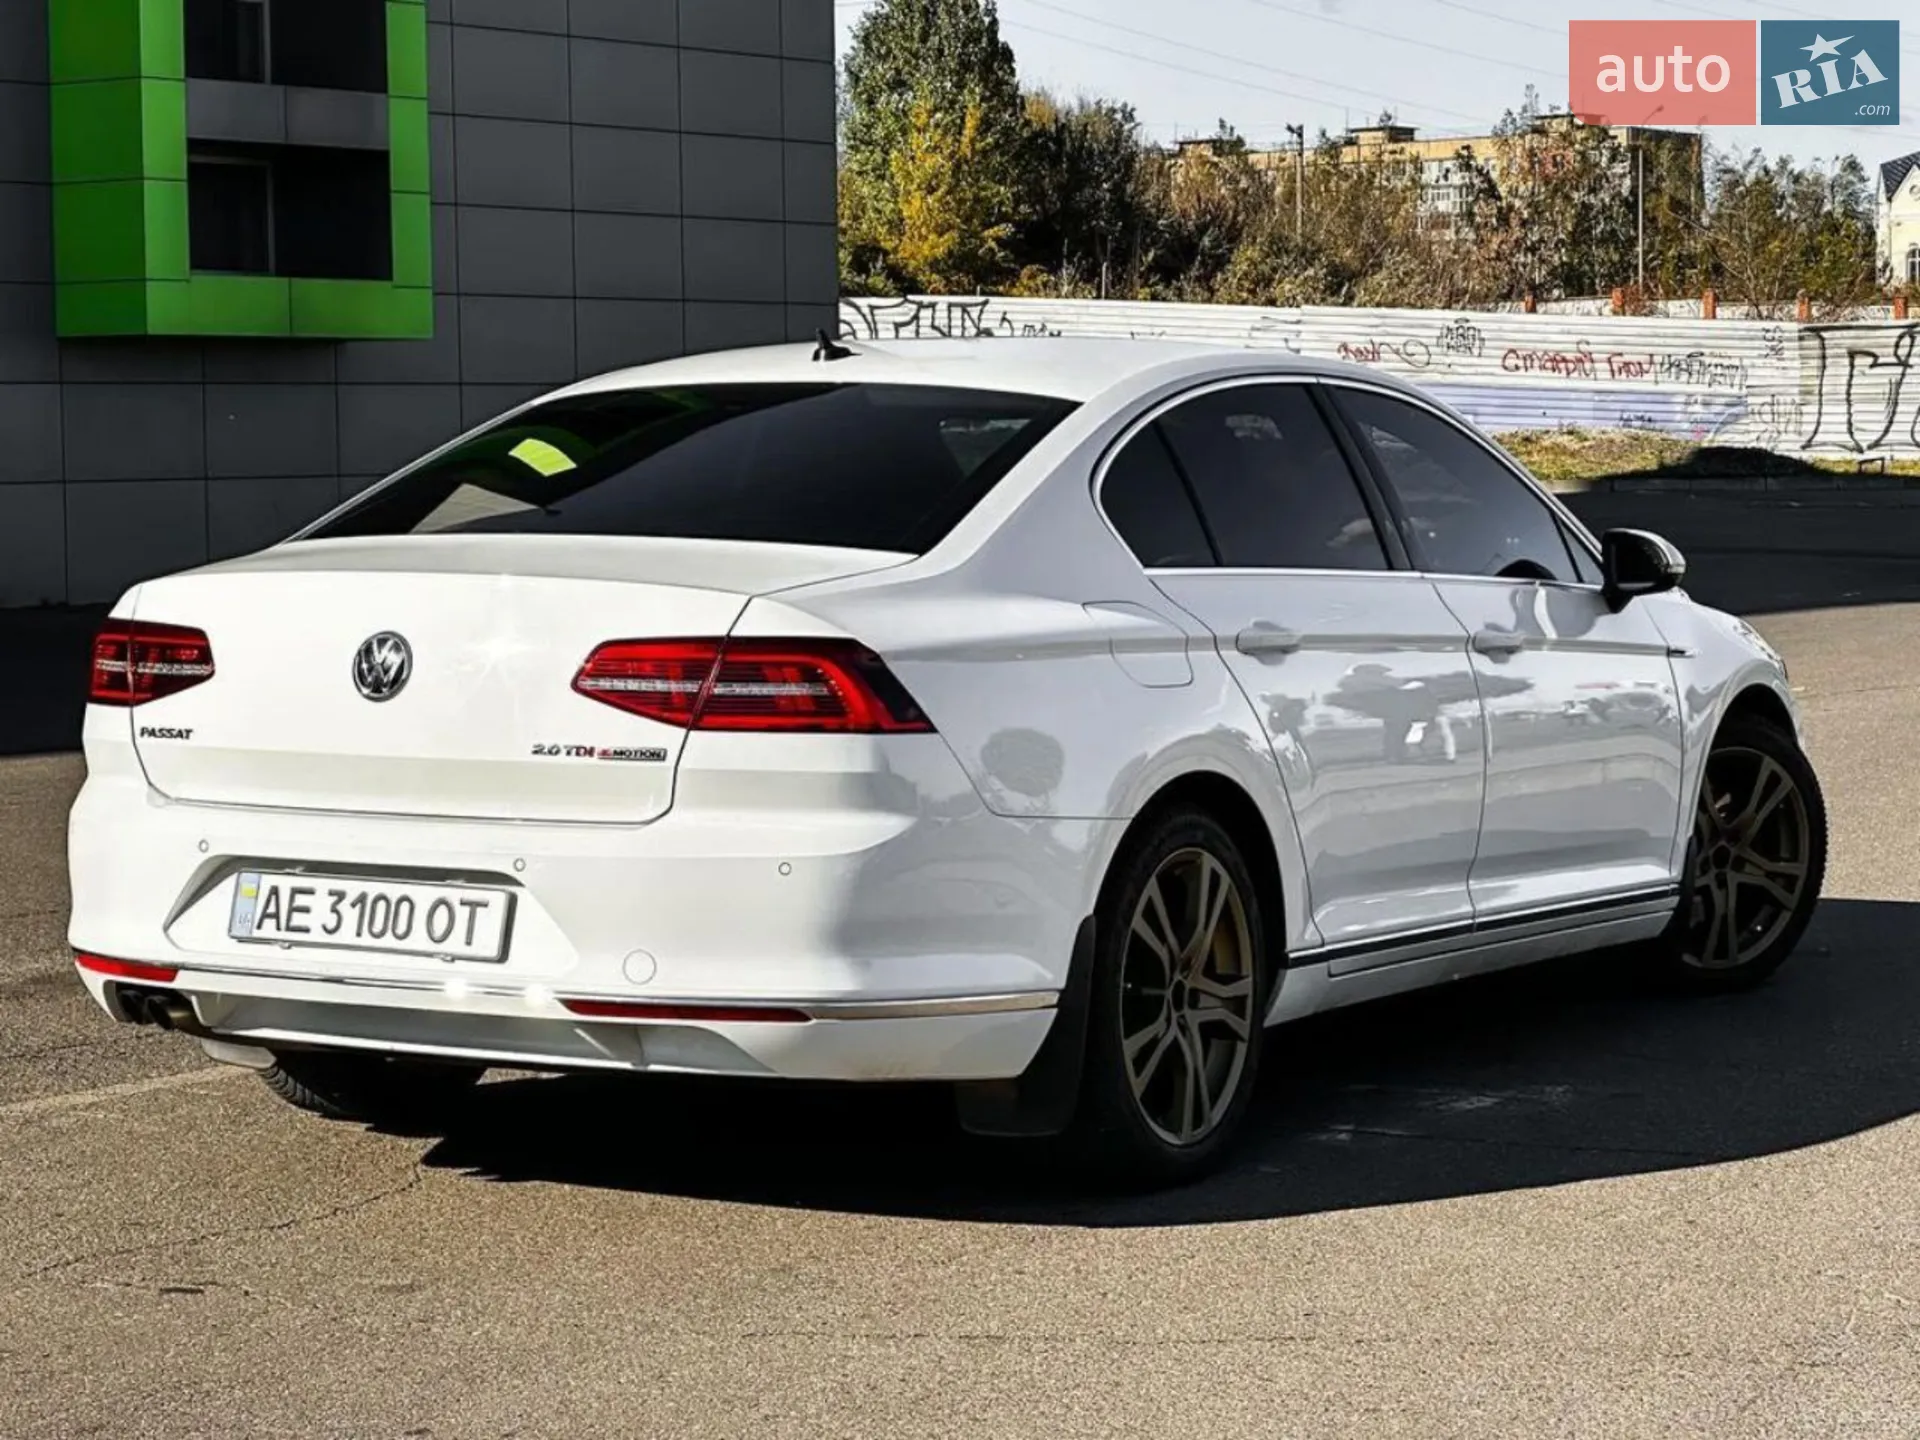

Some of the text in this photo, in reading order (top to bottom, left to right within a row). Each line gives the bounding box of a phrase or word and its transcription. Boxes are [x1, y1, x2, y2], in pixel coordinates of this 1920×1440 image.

[354, 632, 411, 700] VW
[140, 726, 194, 740] PASSAT
[531, 743, 561, 756] 2.0
[563, 745, 596, 758] TDI
[256, 885, 490, 946] AE 3100 OT
